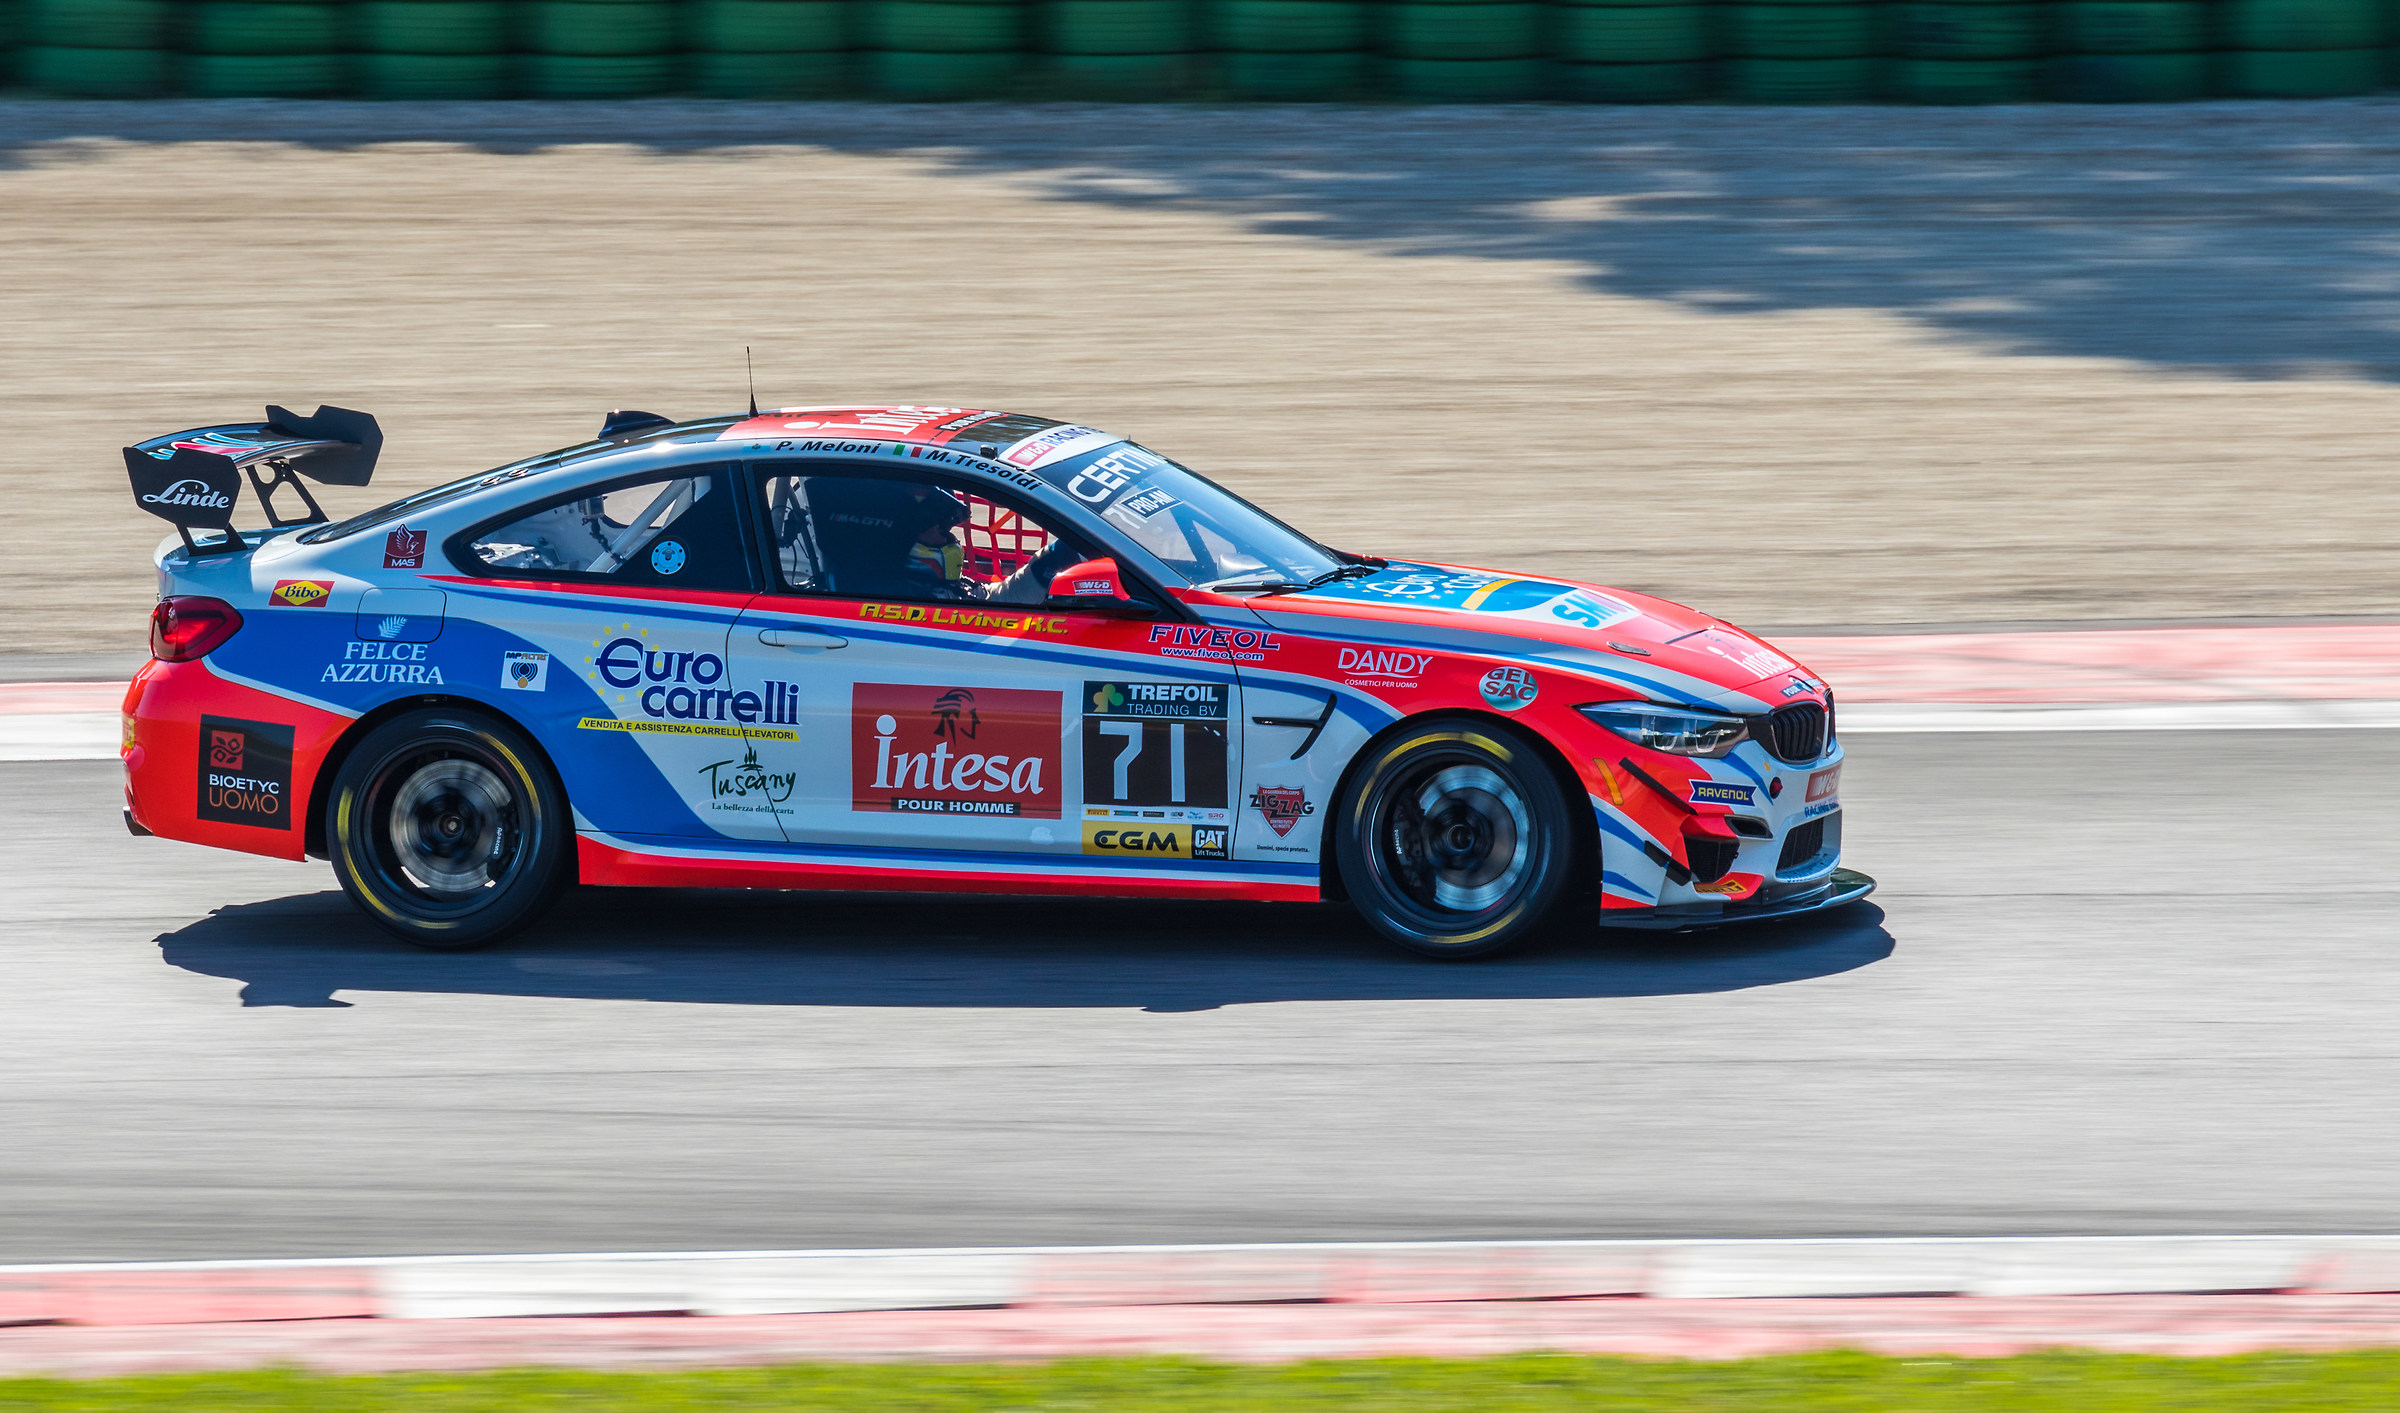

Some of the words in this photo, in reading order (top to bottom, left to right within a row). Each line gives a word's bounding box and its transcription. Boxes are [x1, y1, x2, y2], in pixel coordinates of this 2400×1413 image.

[776, 440, 795, 451] P.
[800, 440, 881, 454] Meloni
[142, 479, 230, 509] Linde
[1127, 489, 1177, 515] PRO-AM
[391, 558, 416, 568] MAS
[284, 584, 321, 600] Bibo
[859, 603, 927, 622] A.S.D.
[1022, 616, 1069, 634] K.C.
[1148, 624, 1281, 651] FIVEOL
[344, 642, 428, 661] FELCE
[1161, 646, 1264, 661] www.fiveol.com
[1338, 648, 1434, 675] DANDY
[594, 637, 724, 689] Euro
[320, 663, 445, 685] AZZURRA
[1344, 678, 1381, 687] COSMETICI
[1487, 668, 1536, 688] GEL
[1128, 684, 1219, 702] TREFOIL
[1483, 681, 1535, 701] SAC
[641, 679, 802, 725] carrelli
[1127, 703, 1190, 716] TRADING
[1199, 705, 1218, 716] BV
[583, 719, 624, 731] VENDITA
[626, 722, 632, 731] E
[634, 722, 693, 734] ASSISTENZA
[694, 726, 741, 738] CARRELLI
[742, 728, 794, 740] ELEVATORI
[1100, 720, 1186, 802] 71
[209, 773, 280, 794] BIOETYC
[698, 760, 797, 802] Tuscany
[209, 787, 279, 814] UOMO
[1698, 787, 1750, 801] RAVENOL
[711, 803, 722, 811] La
[723, 803, 754, 812] bellezza
[755, 805, 775, 813] della
[898, 799, 944, 812] POUR
[949, 801, 1014, 814] HOMME
[1094, 830, 1180, 852] CGM
[1195, 829, 1225, 849] CAT
